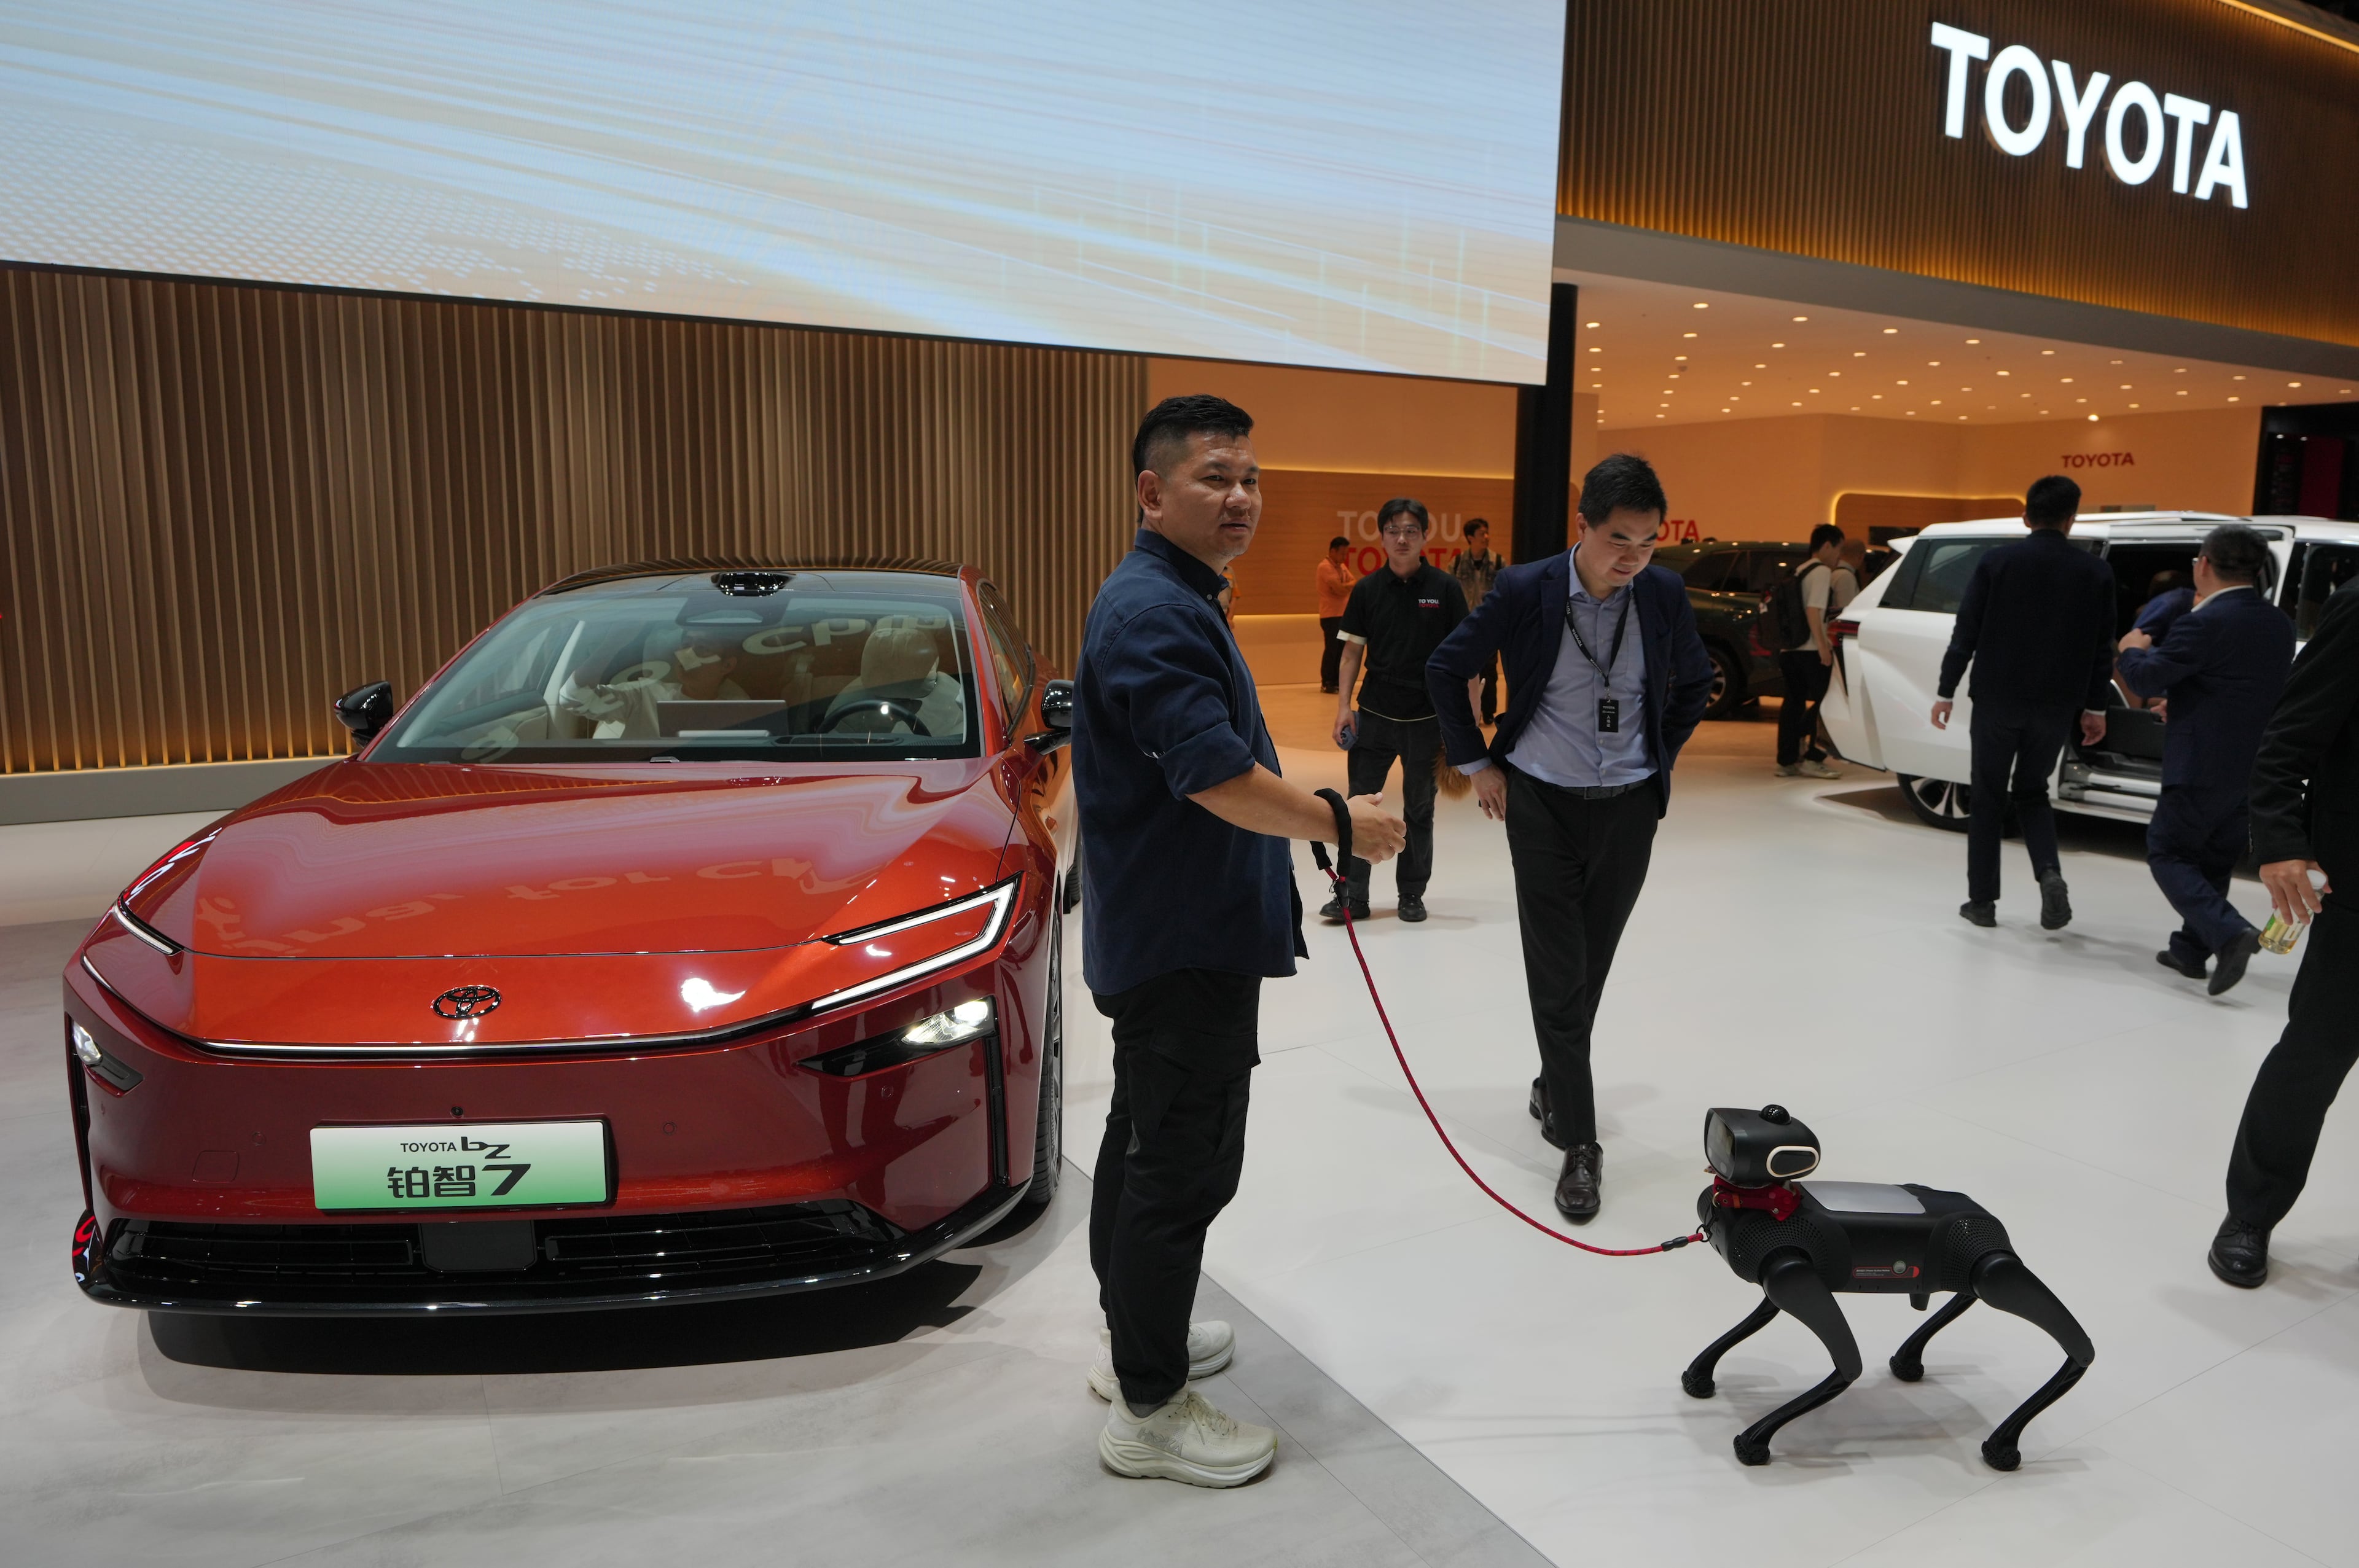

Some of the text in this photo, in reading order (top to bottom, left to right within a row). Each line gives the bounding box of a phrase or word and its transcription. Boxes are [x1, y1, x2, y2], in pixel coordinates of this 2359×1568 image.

[1931, 22, 2248, 209] TOYOTA
[2061, 451, 2135, 468] TOYOTA
[1572, 628, 1583, 647] TOYOTA
[401, 1142, 456, 1152] TOYOTA
[387, 1164, 531, 1198] 铂智7
[1136, 1426, 1181, 1455] HOKA
